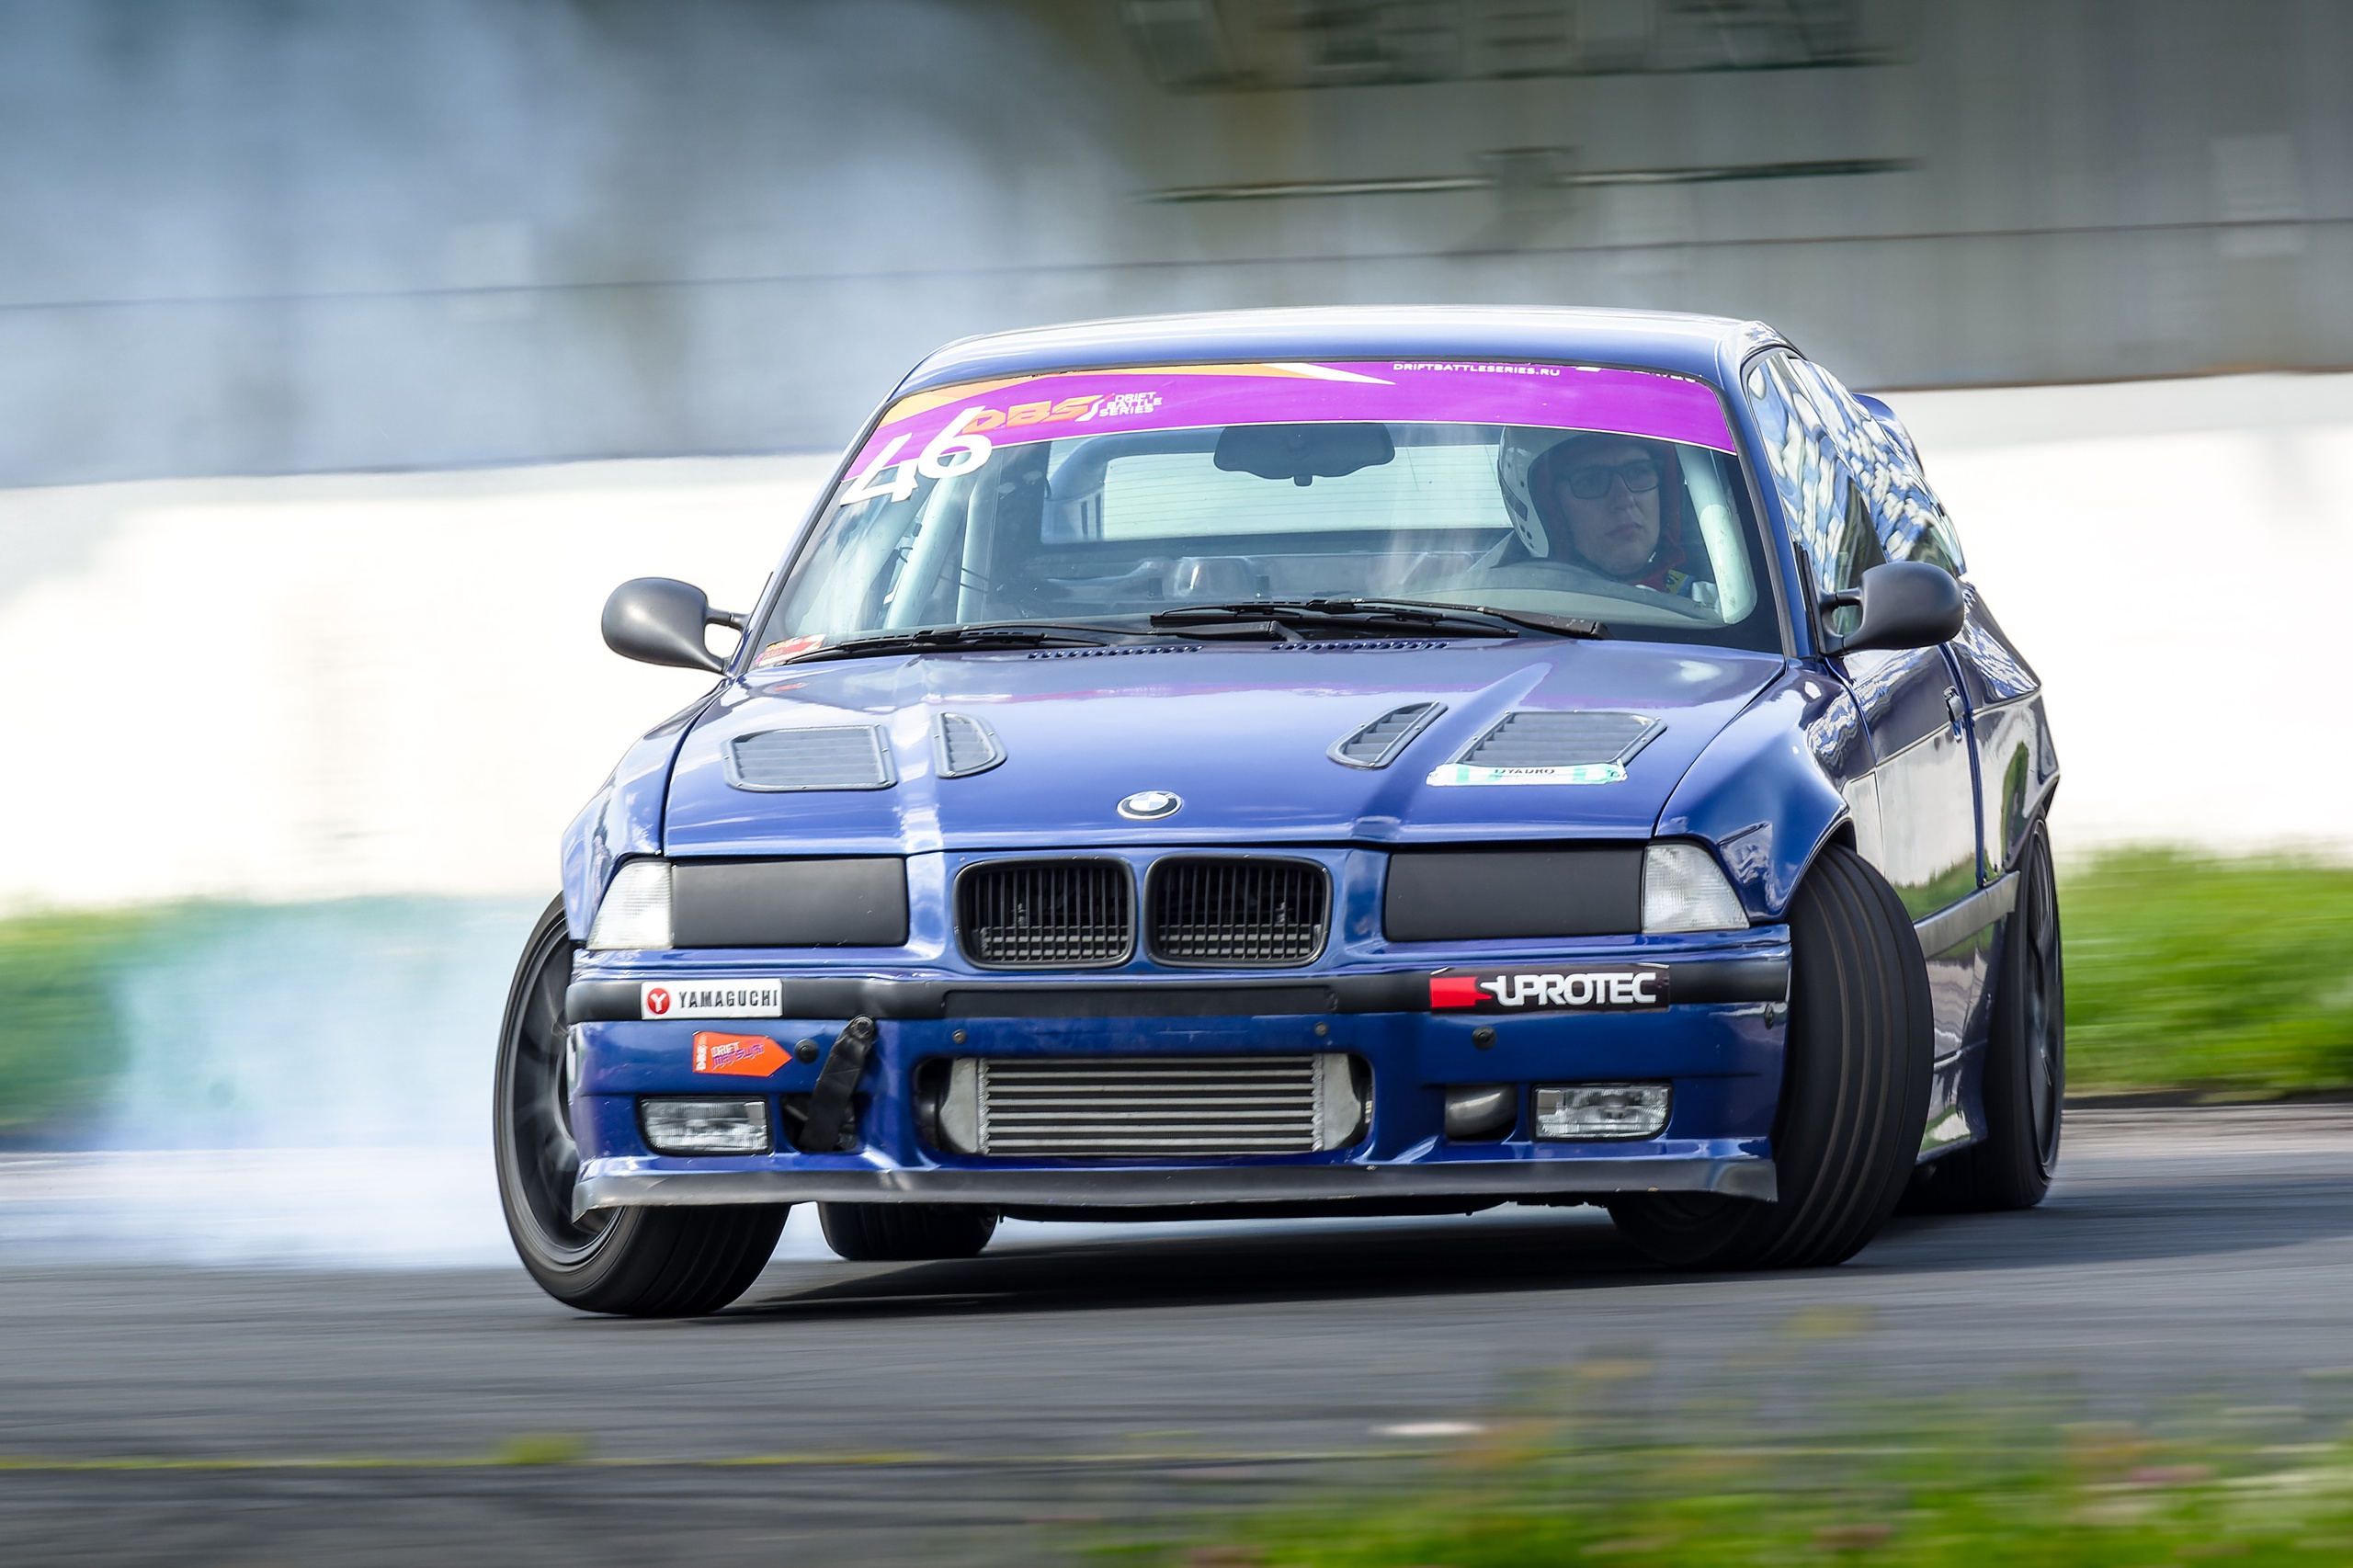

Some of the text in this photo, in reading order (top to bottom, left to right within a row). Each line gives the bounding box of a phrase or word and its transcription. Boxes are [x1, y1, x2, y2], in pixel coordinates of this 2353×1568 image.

[1392, 362, 1561, 377] DRIFTBATTLESERIES.RU
[1106, 397, 1163, 410] BATTLE
[1115, 391, 1157, 403] DRIFT
[962, 394, 1104, 434] DBS
[1098, 403, 1154, 417] SERIES
[839, 405, 993, 506] 46
[678, 990, 779, 1008] YAMAGUCHI
